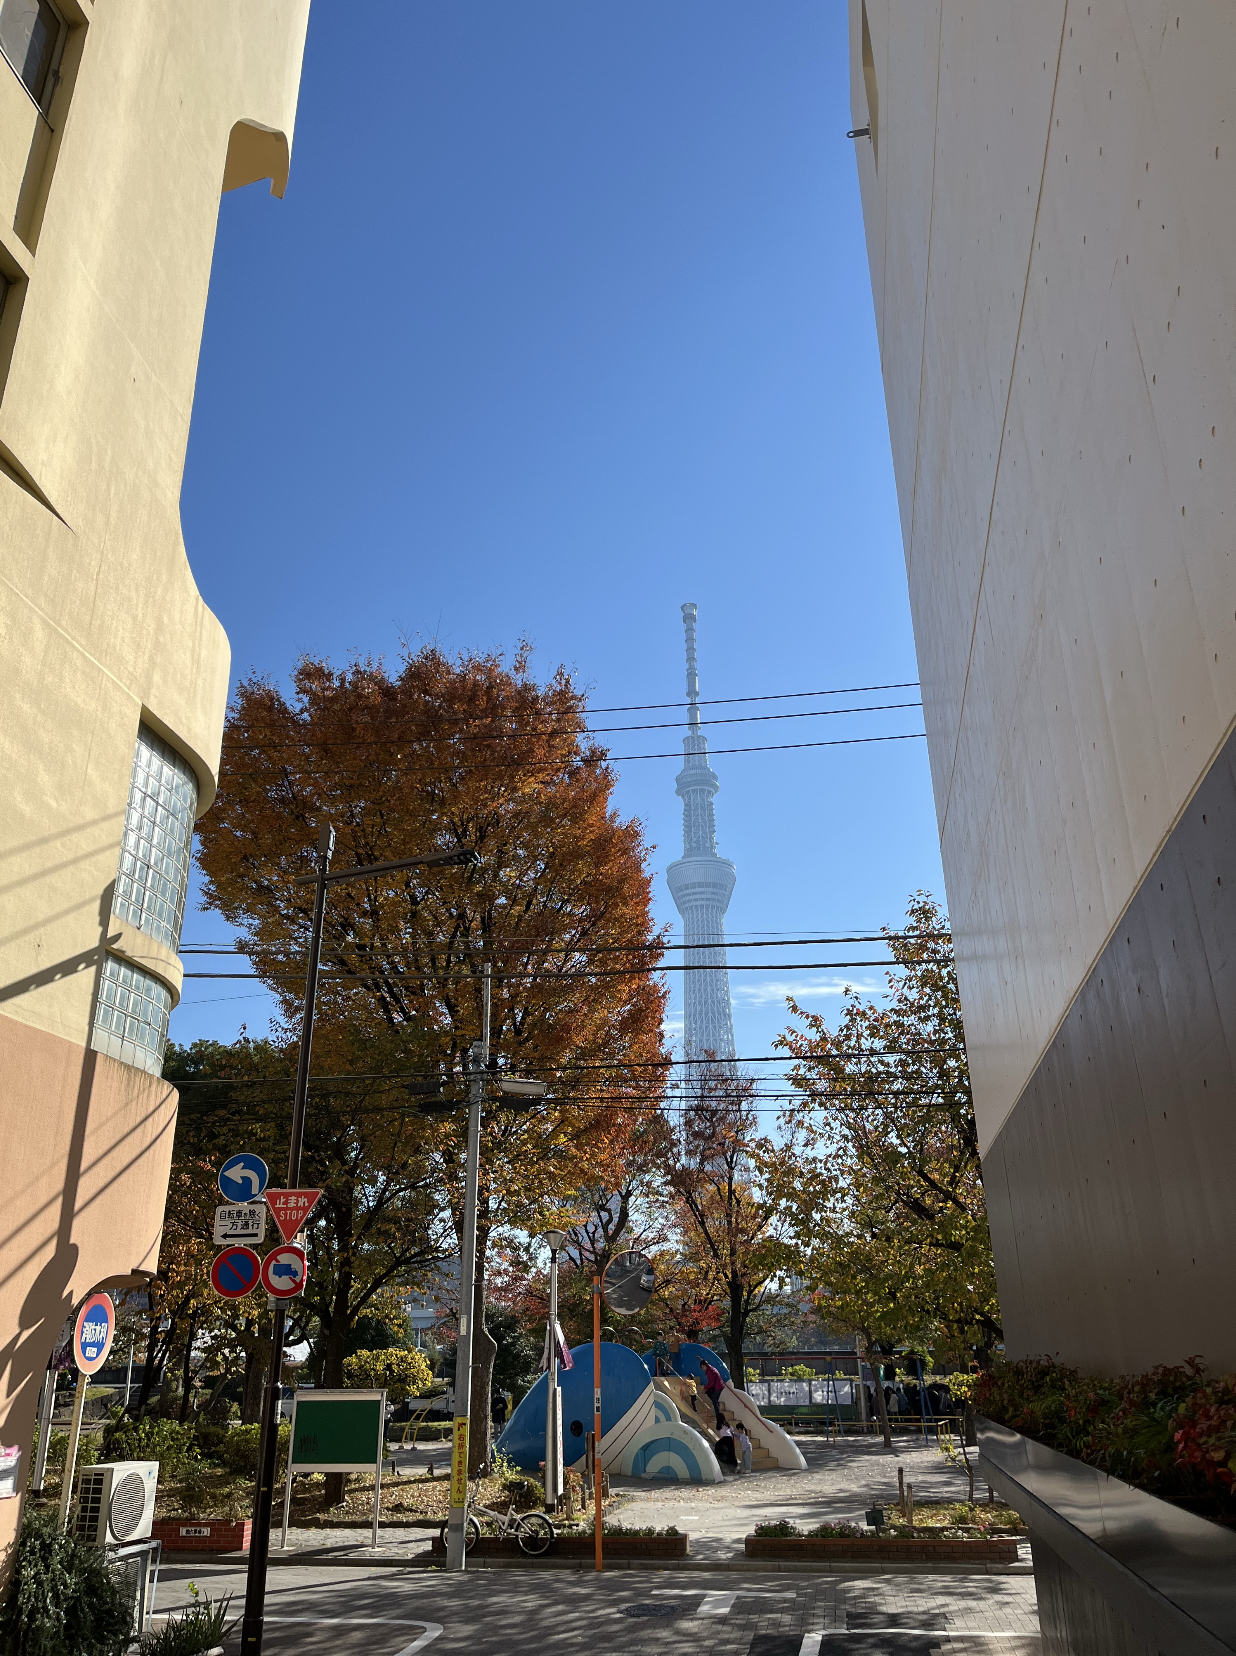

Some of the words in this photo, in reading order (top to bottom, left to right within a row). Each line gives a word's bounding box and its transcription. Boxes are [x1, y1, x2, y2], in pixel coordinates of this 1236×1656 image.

[275, 1195, 309, 1208] 止まれ
[219, 1208, 261, 1220] 自転車を除く
[280, 1210, 304, 1220] STOP
[219, 1220, 261, 1231] 一方通行
[81, 1321, 108, 1343] 消防水利
[456, 1433, 466, 1494] 右折できません
